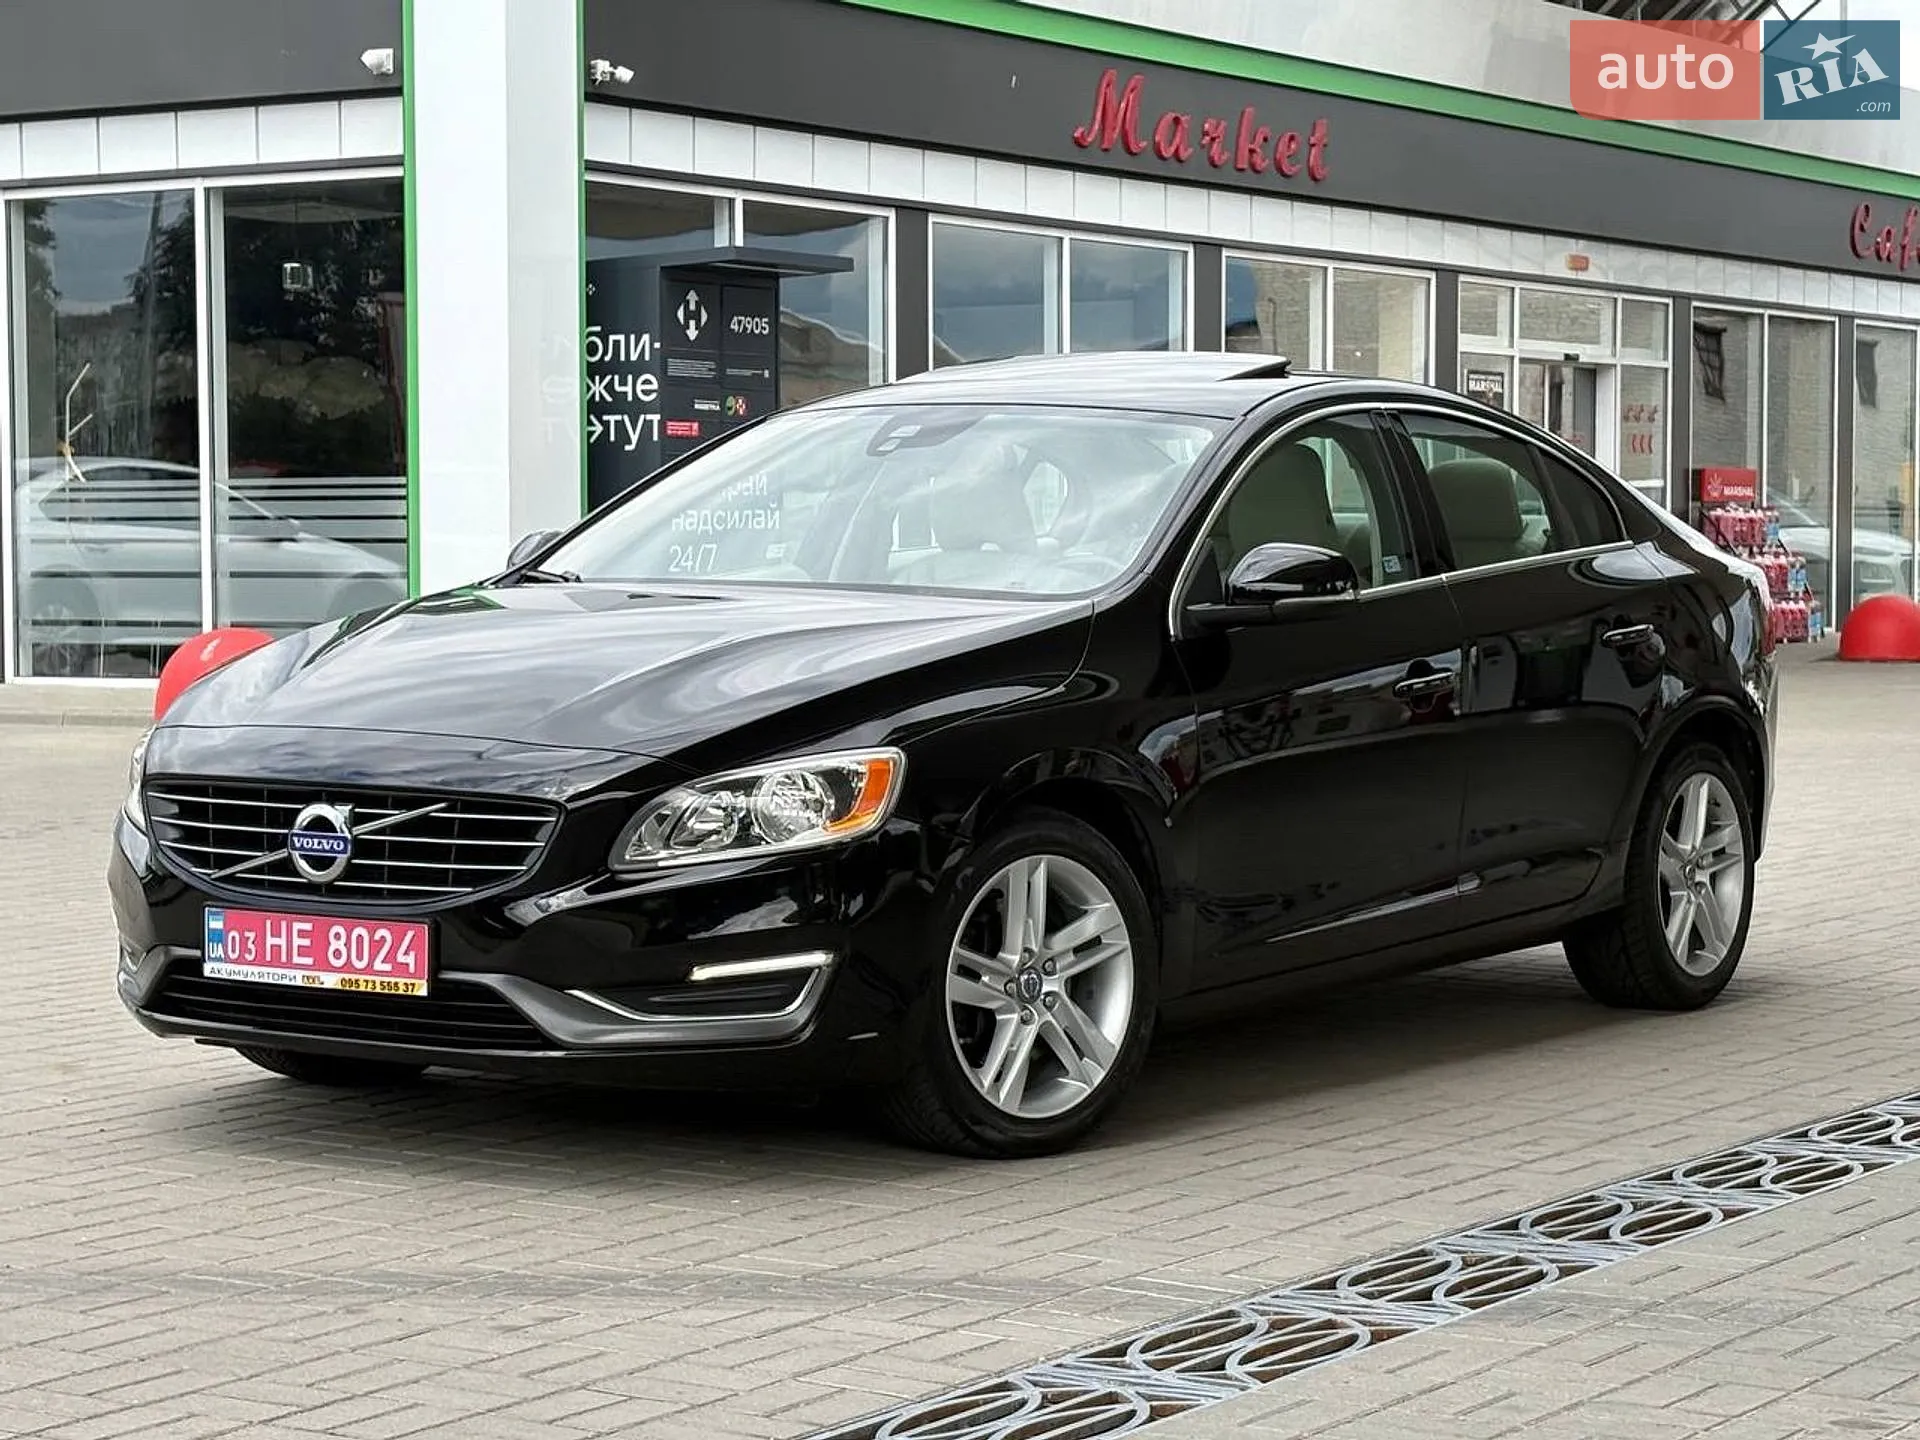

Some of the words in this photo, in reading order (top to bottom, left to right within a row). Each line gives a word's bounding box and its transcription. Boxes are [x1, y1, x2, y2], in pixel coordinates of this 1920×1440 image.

[1073, 67, 1330, 182] Market
[1849, 202, 1920, 271] Caf
[730, 314, 770, 336] 47905
[585, 373, 660, 403] жче
[602, 413, 661, 452] тут
[671, 503, 780, 535] надсилай
[668, 544, 717, 573] 24/7
[292, 836, 345, 851] VOLVO
[208, 941, 224, 959] UA
[227, 930, 257, 962] 03
[326, 924, 416, 974] 8024
[208, 966, 297, 984] АКУМУЛЯТОРИ
[340, 977, 361, 989] 095
[362, 979, 377, 990] 73
[402, 981, 416, 993] 37
